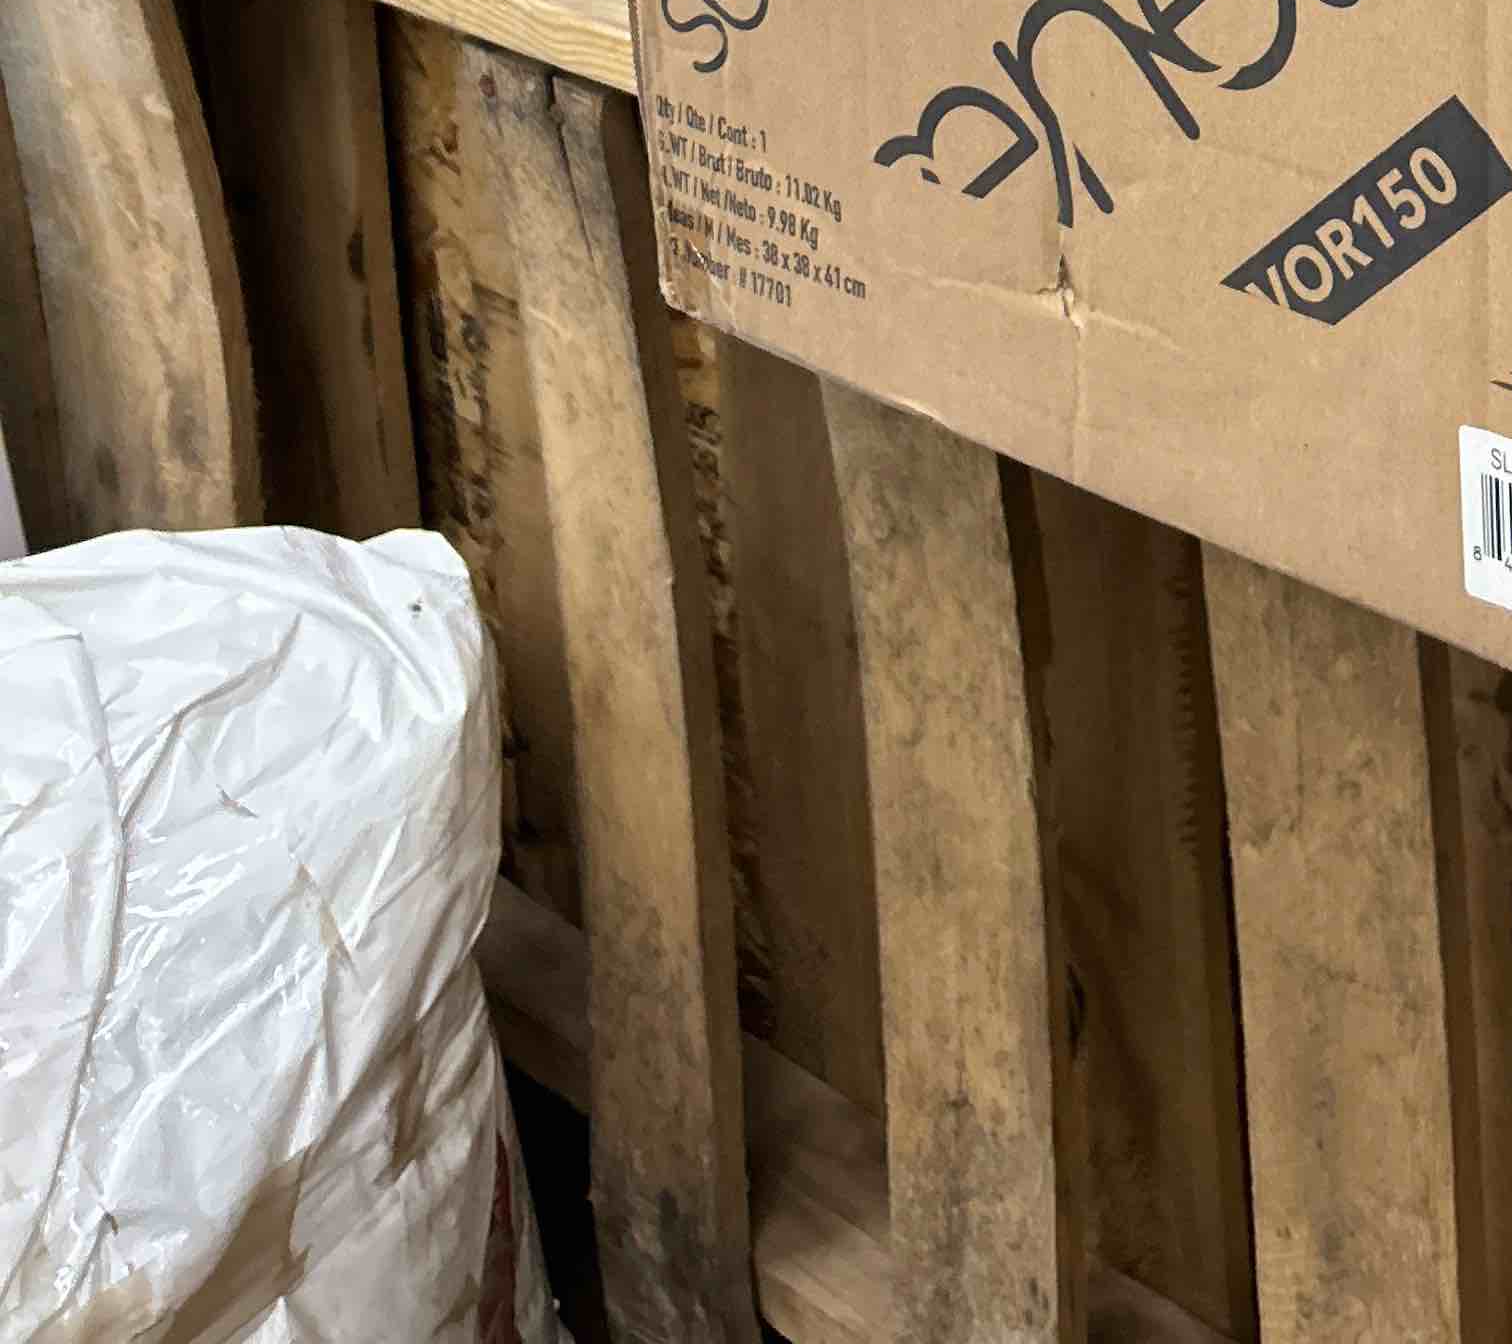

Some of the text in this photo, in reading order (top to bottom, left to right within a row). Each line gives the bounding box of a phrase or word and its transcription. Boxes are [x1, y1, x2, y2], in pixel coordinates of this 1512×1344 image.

[736, 159, 772, 191] Bruto
[785, 174, 820, 208] 11.02
[823, 190, 842, 222] Kg
[768, 206, 796, 236] 9.98
[800, 217, 818, 251] Kg
[752, 271, 791, 307] 17701
[762, 240, 778, 266] 38
[793, 252, 810, 278] 38
[824, 264, 841, 289] 41
[844, 276, 866, 298] cm
[1472, 545, 1482, 561] 8
